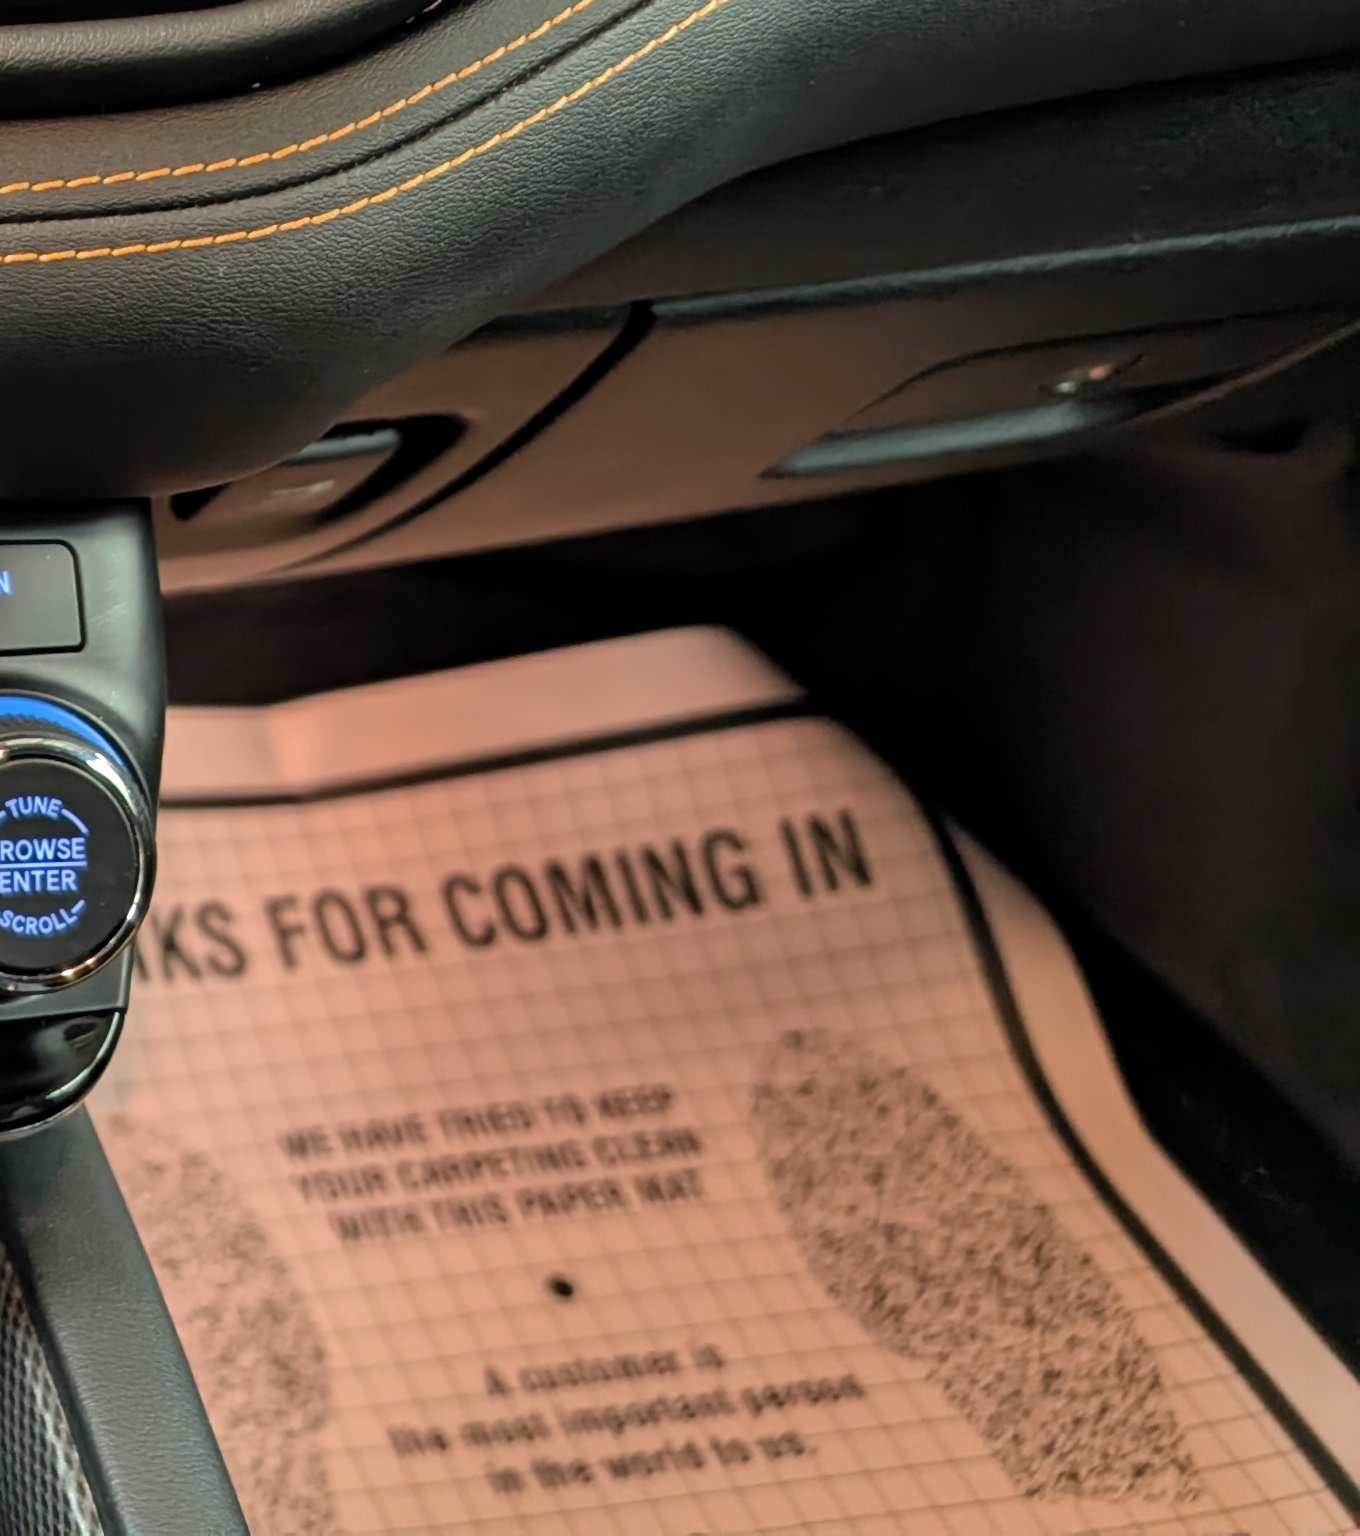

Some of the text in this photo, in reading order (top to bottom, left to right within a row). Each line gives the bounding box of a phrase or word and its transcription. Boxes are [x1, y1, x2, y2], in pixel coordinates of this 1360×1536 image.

[5, 796, 62, 819] TUNE
[264, 884, 427, 970] FOR
[442, 828, 760, 949] COMING
[778, 808, 874, 899] IN
